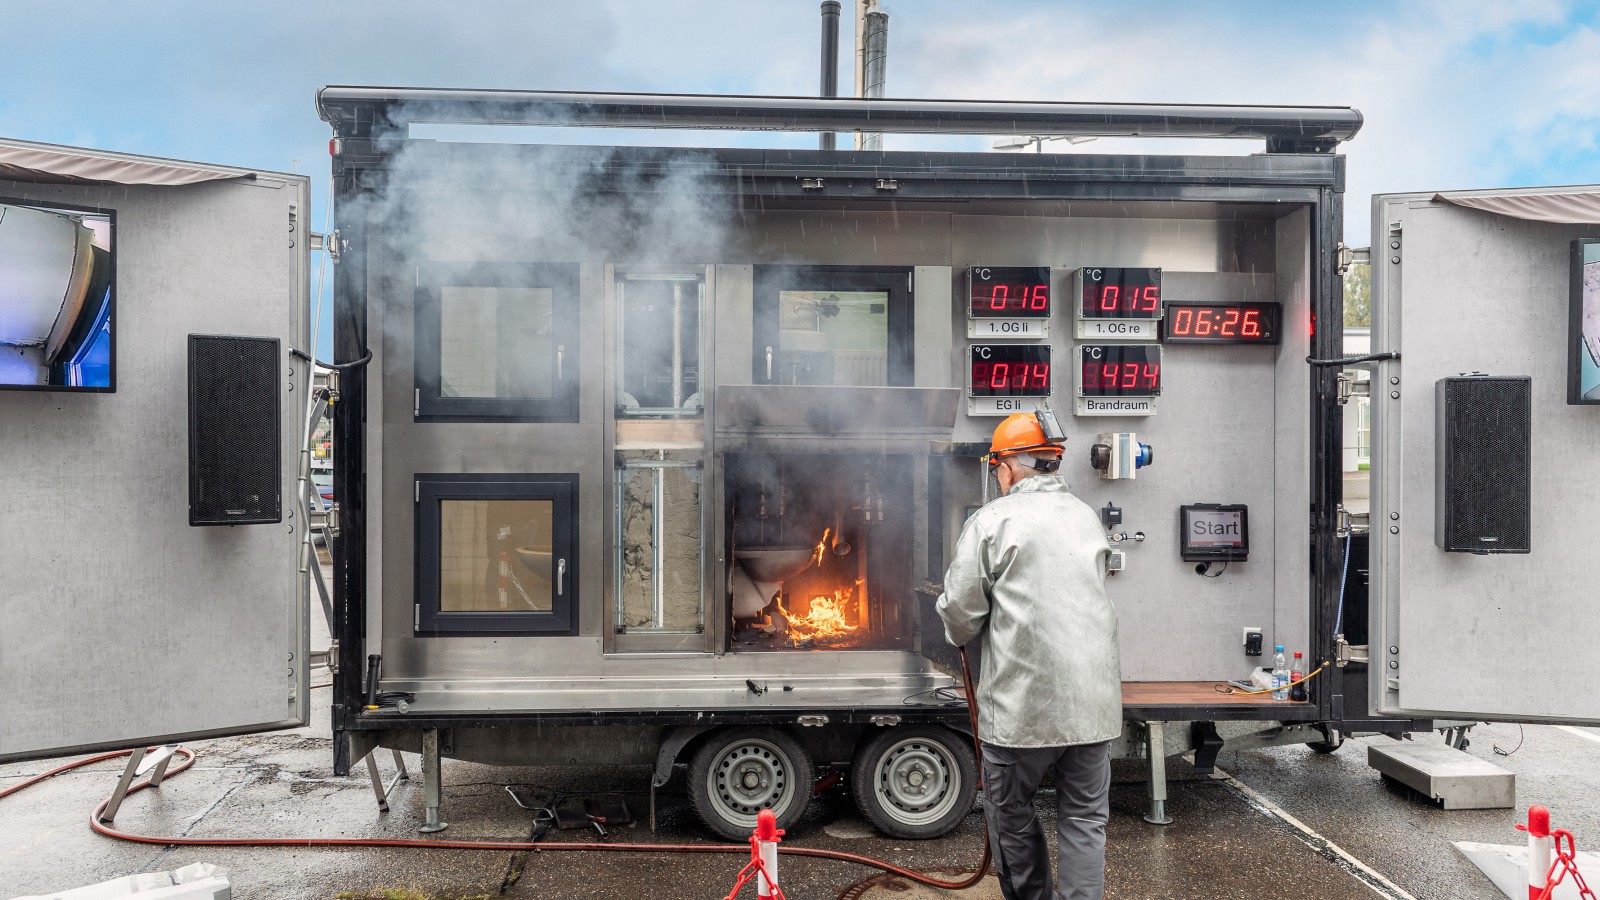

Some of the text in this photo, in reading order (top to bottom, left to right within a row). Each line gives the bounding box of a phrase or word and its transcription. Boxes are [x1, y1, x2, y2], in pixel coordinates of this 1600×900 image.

[975, 268, 991, 280] °C
[1086, 269, 1102, 281] °C
[990, 285, 1048, 310] 016
[1101, 286, 1158, 311] 015
[989, 322, 1029, 333] 1. OG li
[1096, 323, 1140, 333] 1. OG re
[975, 346, 991, 359] °C
[1085, 347, 1102, 359] °C
[990, 363, 1049, 388] 014
[1102, 363, 1159, 388] 434
[996, 400, 1021, 410] EG li
[1087, 400, 1149, 410] Brandraum
[1193, 520, 1239, 535] Start
